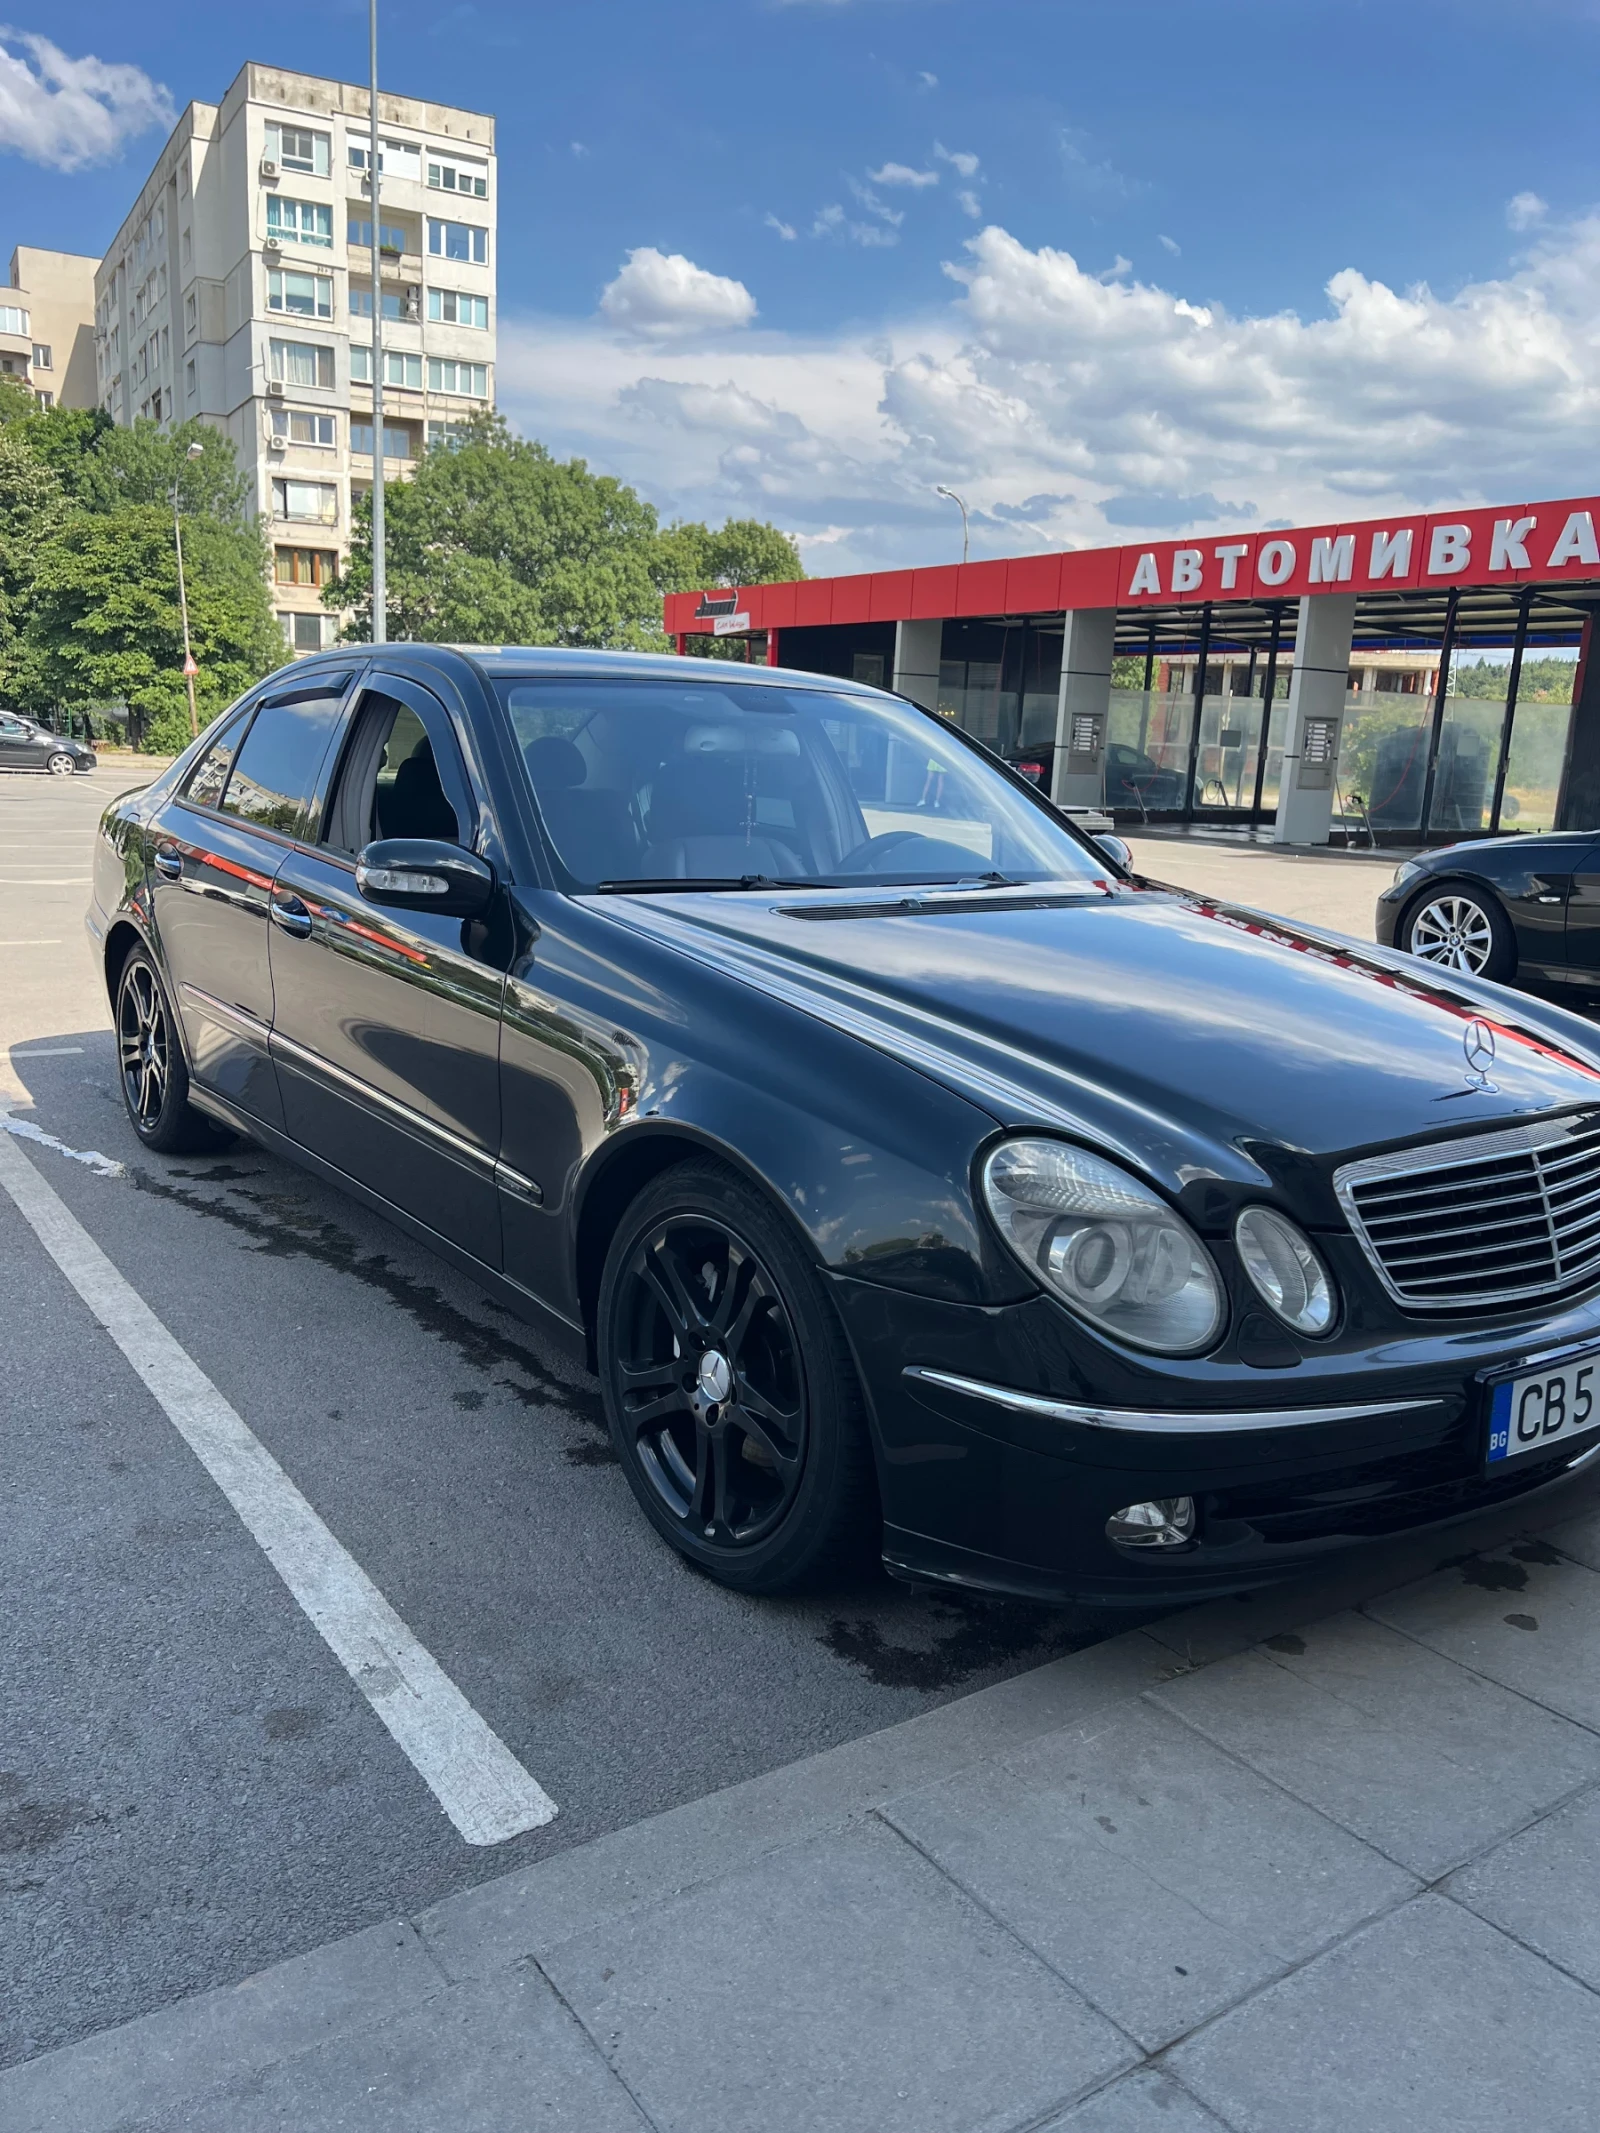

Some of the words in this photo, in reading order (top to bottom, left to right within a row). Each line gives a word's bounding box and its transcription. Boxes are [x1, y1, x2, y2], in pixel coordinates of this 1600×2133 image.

[1128, 511, 1600, 596] АВТОМИВКА
[1489, 1430, 1508, 1451] BG
[1517, 1376, 1566, 1442] CB
